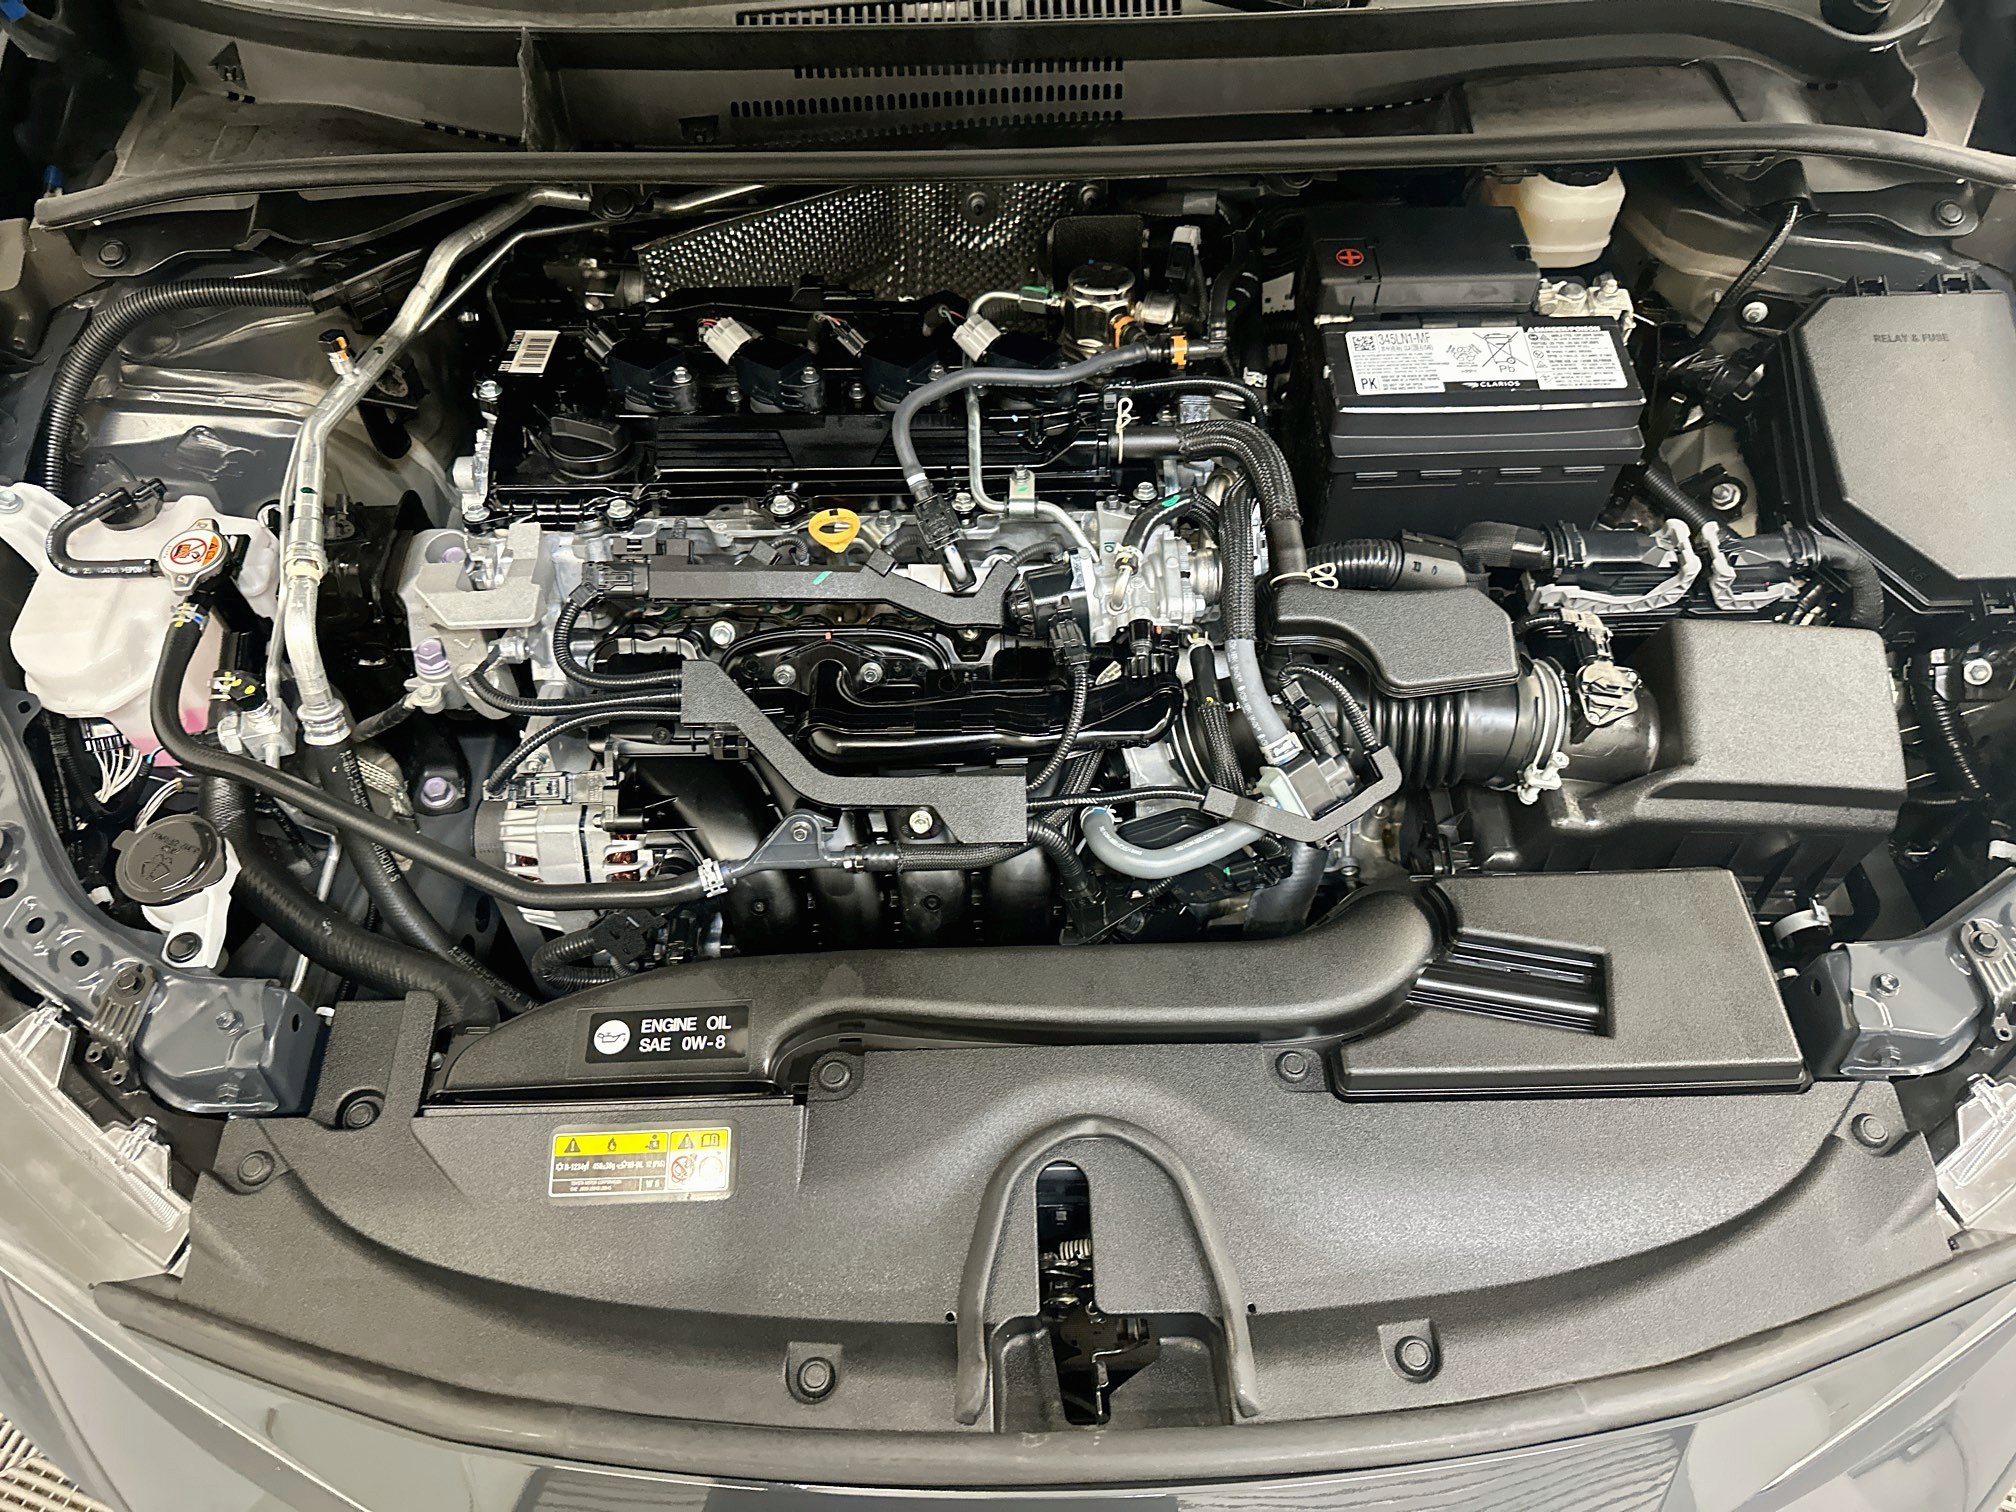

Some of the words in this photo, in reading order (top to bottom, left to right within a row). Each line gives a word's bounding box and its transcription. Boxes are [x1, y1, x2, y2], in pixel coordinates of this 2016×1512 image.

[1378, 332, 1430, 345] 345LN1-MF
[1873, 334, 1907, 342] RELAY
[1922, 333, 1949, 342] FUSE
[1499, 365, 1515, 373] Pb
[1361, 377, 1377, 389] PK
[640, 1017, 697, 1033] ENGINE
[706, 1015, 731, 1030] OIL
[639, 1037, 671, 1052] SAE
[681, 1035, 726, 1050] 0W-8
